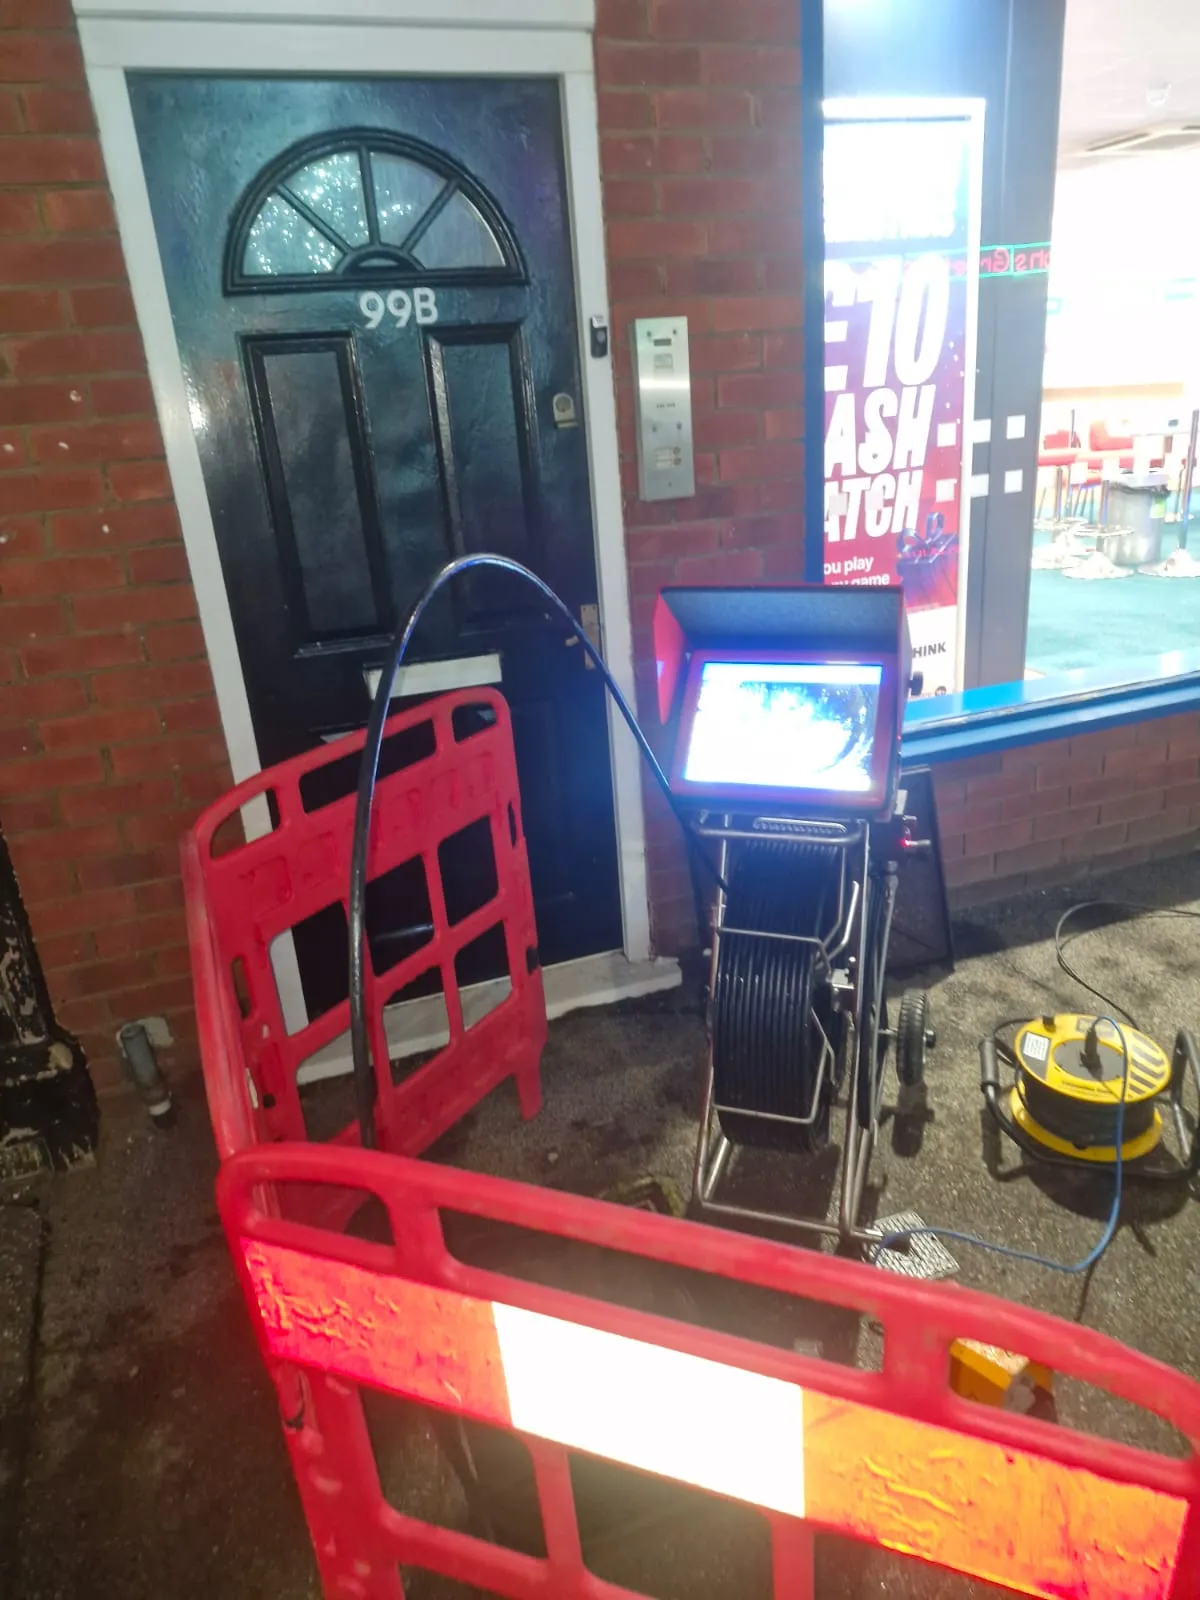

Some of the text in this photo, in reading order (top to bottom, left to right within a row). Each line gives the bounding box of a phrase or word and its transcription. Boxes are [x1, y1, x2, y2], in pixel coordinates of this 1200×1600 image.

[360, 287, 438, 329] 99B
[824, 384, 936, 478] ASH
[824, 470, 923, 542] ATCH
[824, 556, 874, 575] ou play
[913, 641, 947, 659] HINK
